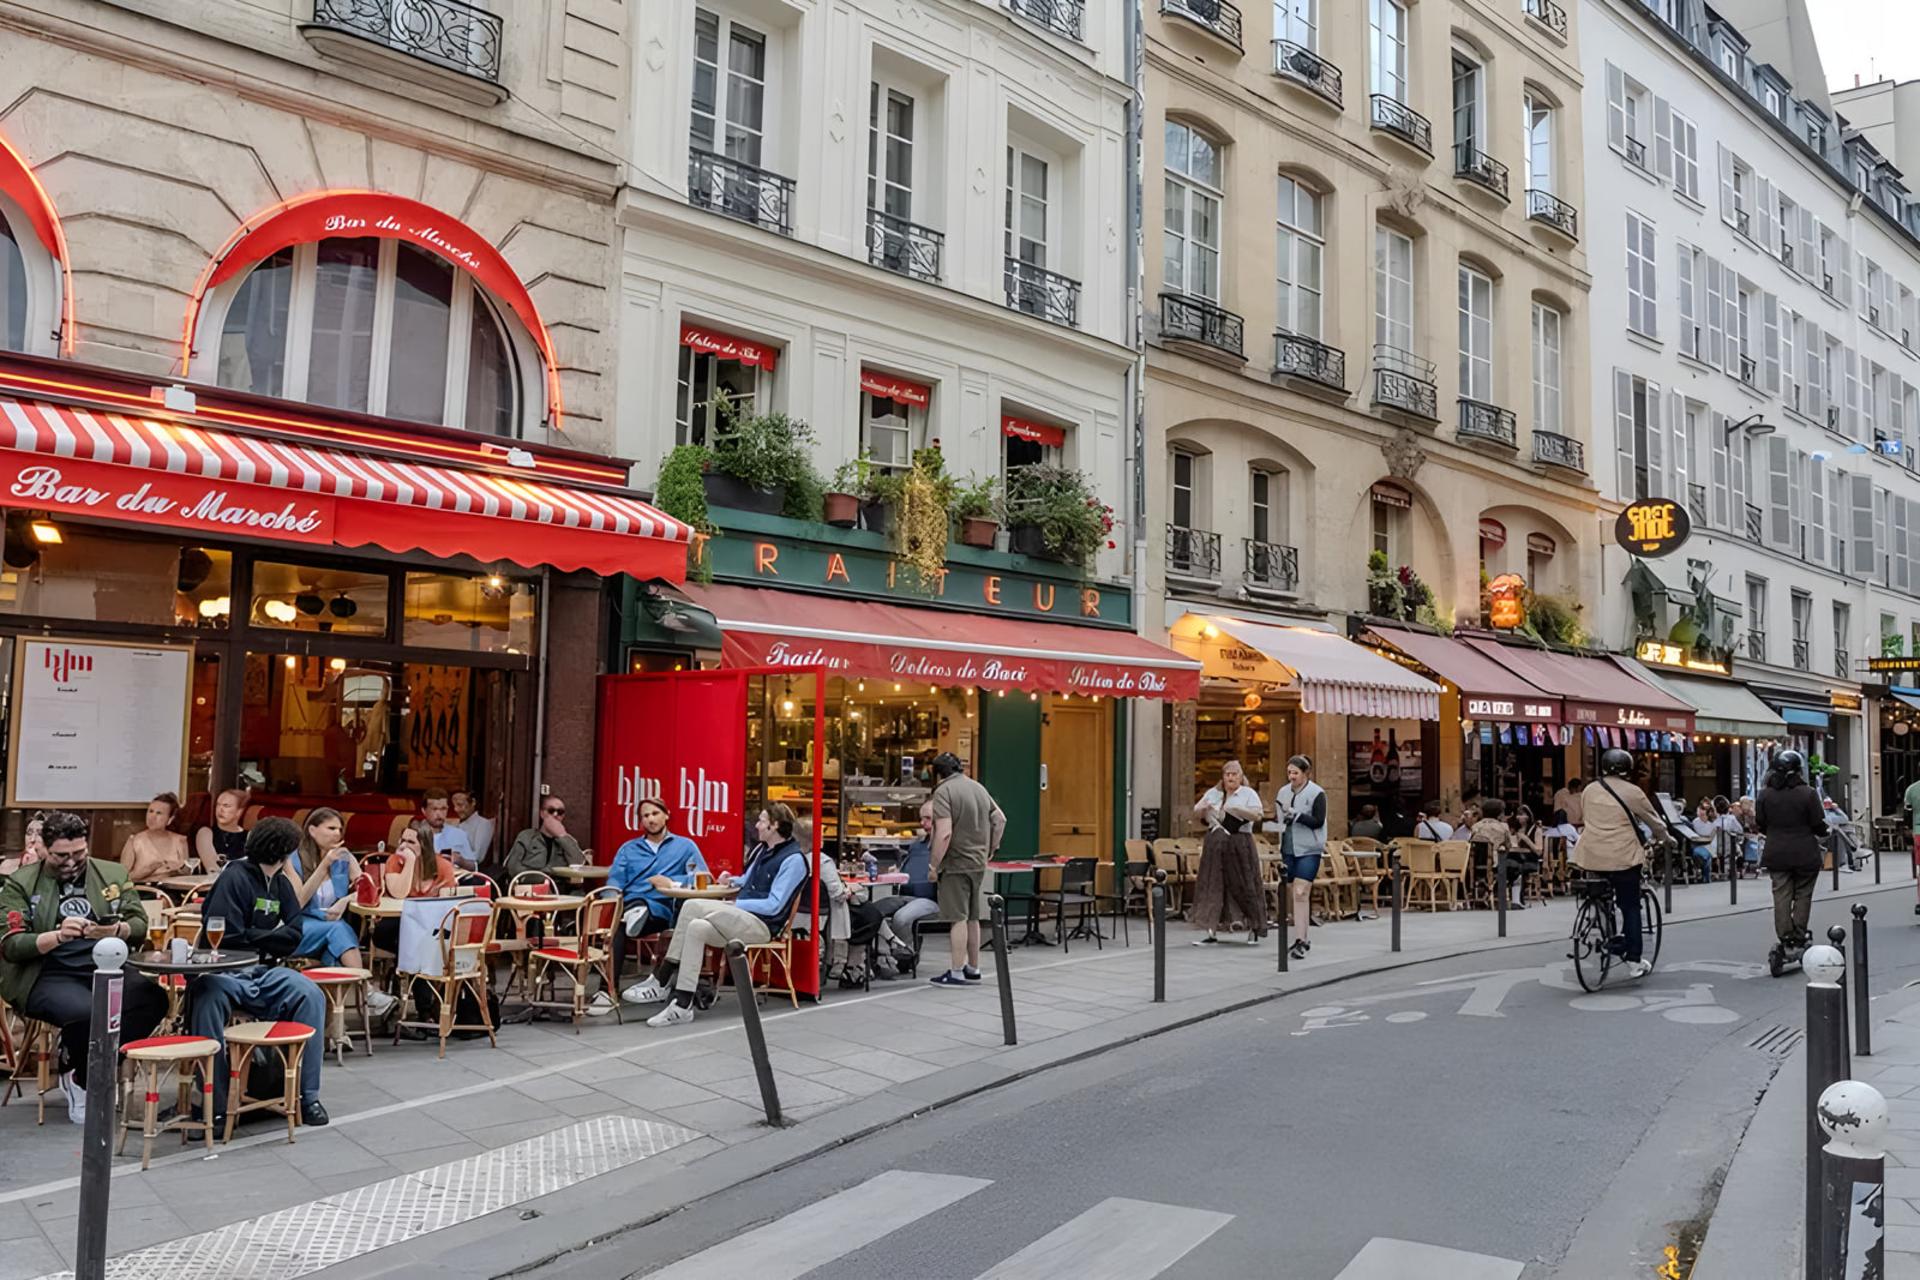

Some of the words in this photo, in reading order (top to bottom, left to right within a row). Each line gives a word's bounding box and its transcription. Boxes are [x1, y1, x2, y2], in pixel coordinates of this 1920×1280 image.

[325, 214, 365, 231] Bar
[375, 215, 400, 231] du
[10, 465, 110, 506] Bar
[117, 482, 178, 514] du
[180, 490, 322, 533] Marché
